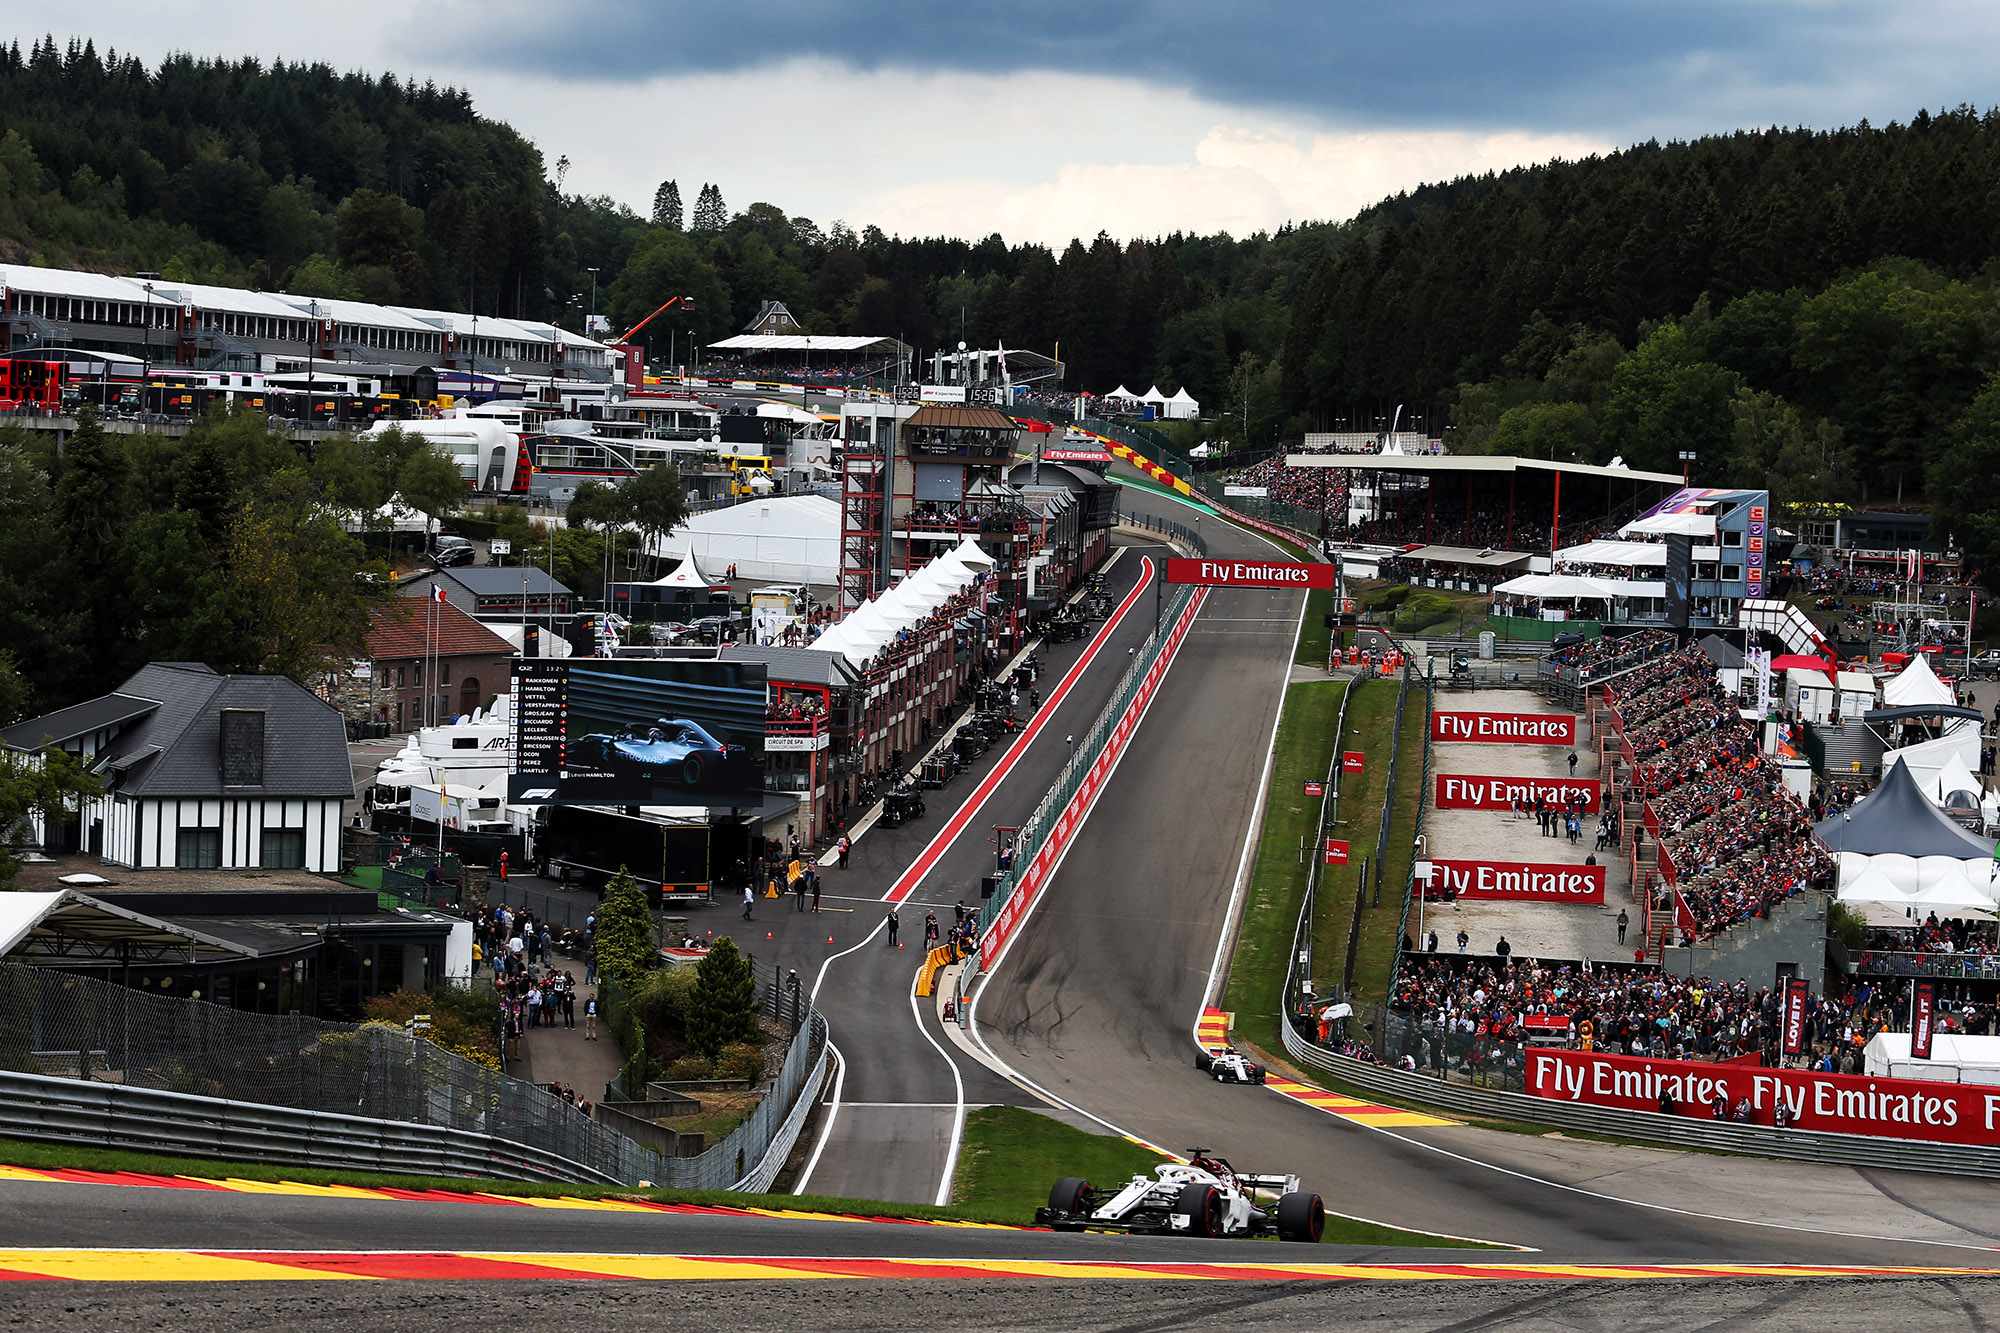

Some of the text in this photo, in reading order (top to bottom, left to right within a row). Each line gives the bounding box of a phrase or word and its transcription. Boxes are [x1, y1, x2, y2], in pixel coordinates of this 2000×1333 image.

[970, 389, 995, 401] 15:26
[1050, 450, 1104, 460] Fly Emirates
[1201, 562, 1310, 582] Fly Emirates
[1439, 715, 1568, 738] Fly Emirates
[615, 750, 664, 764] PETRONAS
[1446, 779, 1592, 805] Fly Emirates
[1477, 866, 1595, 894] Emirates
[1792, 995, 1801, 1010] IT
[1920, 998, 1929, 1013] IT
[1788, 1010, 1800, 1048] LOVE
[1917, 1015, 1928, 1050] FEEL
[1536, 1056, 1585, 1100] Fly
[1593, 1062, 1728, 1104] Emirates
[1753, 1076, 1806, 1121] Fly
[1814, 1080, 1958, 1126] Emirates
